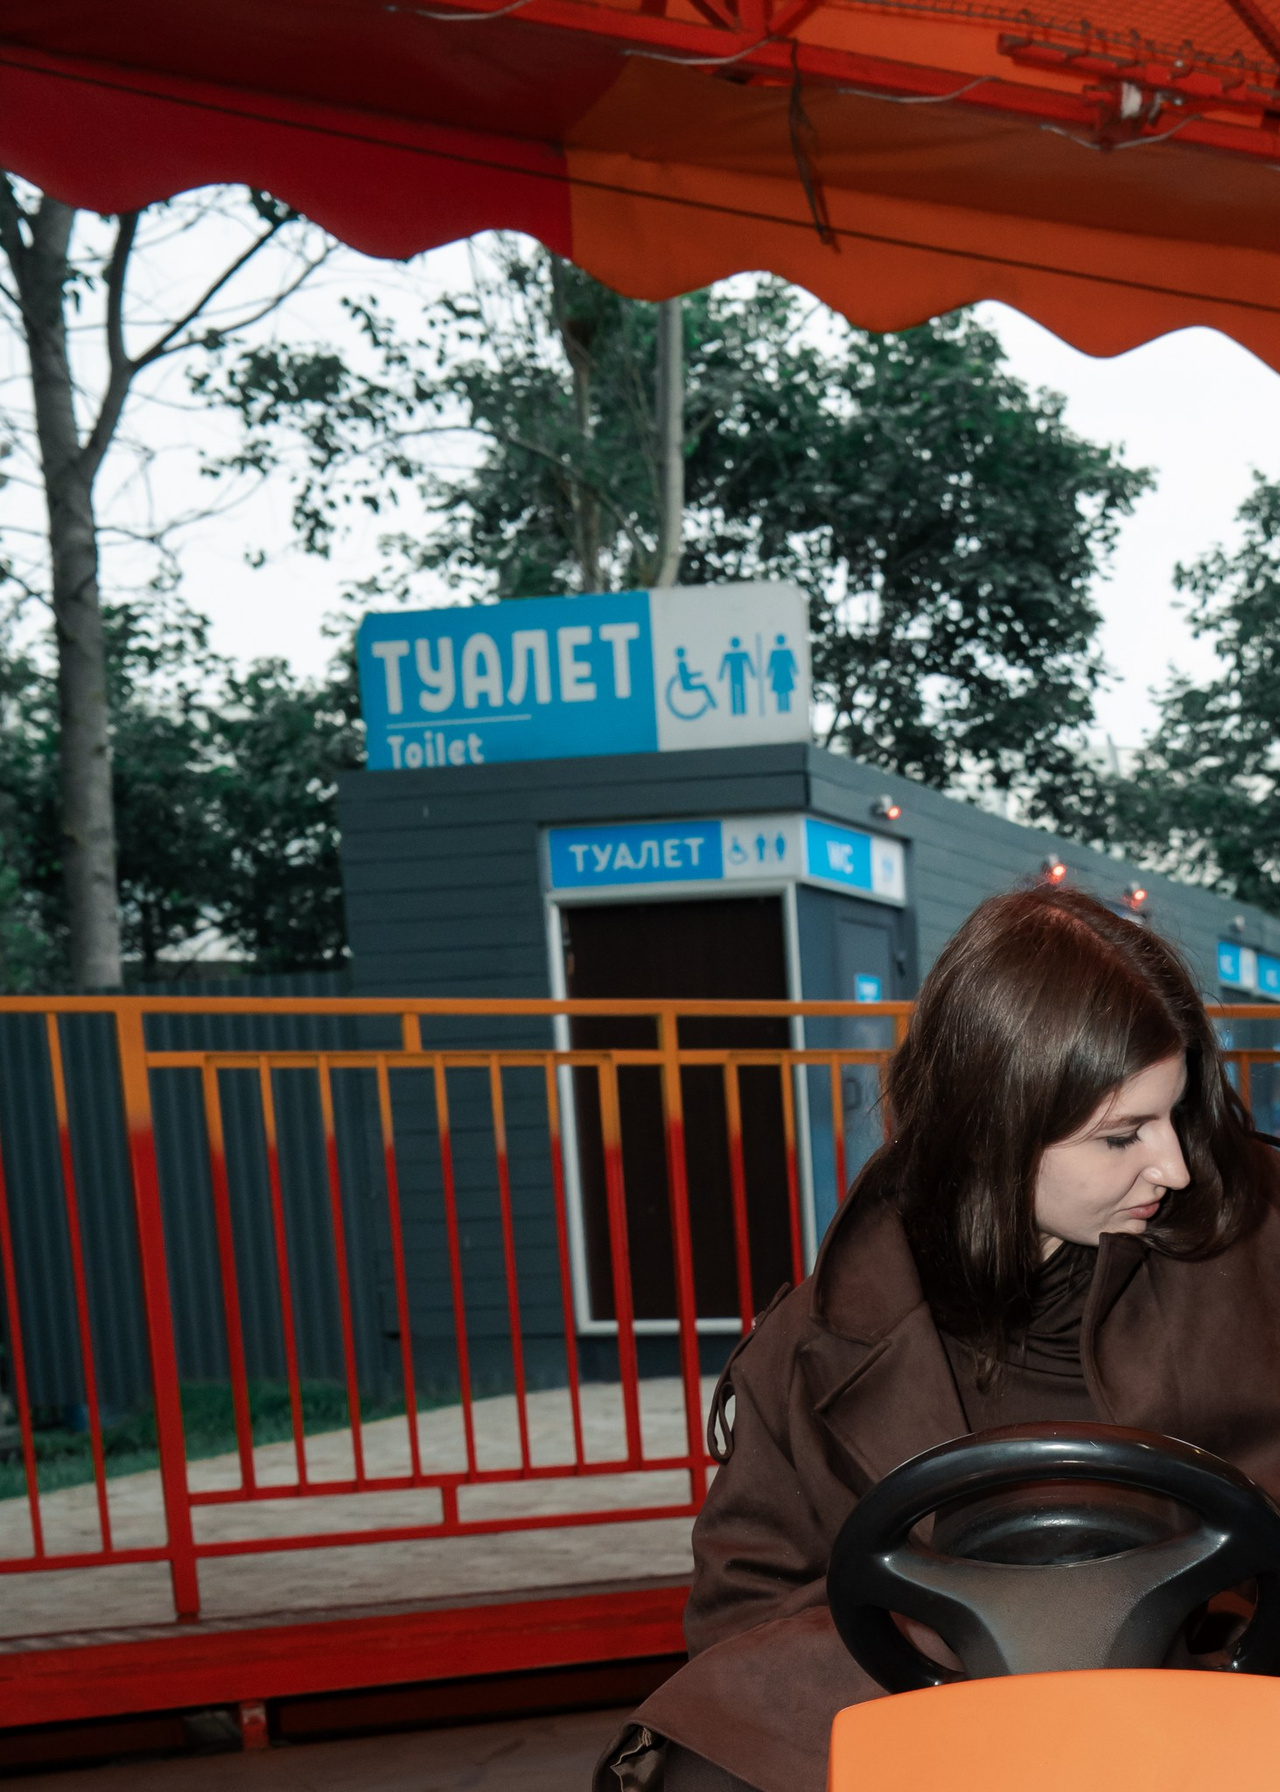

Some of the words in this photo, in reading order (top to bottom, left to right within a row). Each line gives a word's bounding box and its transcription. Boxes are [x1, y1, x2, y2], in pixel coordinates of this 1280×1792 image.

[371, 622, 640, 715] ТУАЛЕТ
[387, 730, 484, 770] Toilet
[568, 836, 704, 874] ТУАЛЕТ
